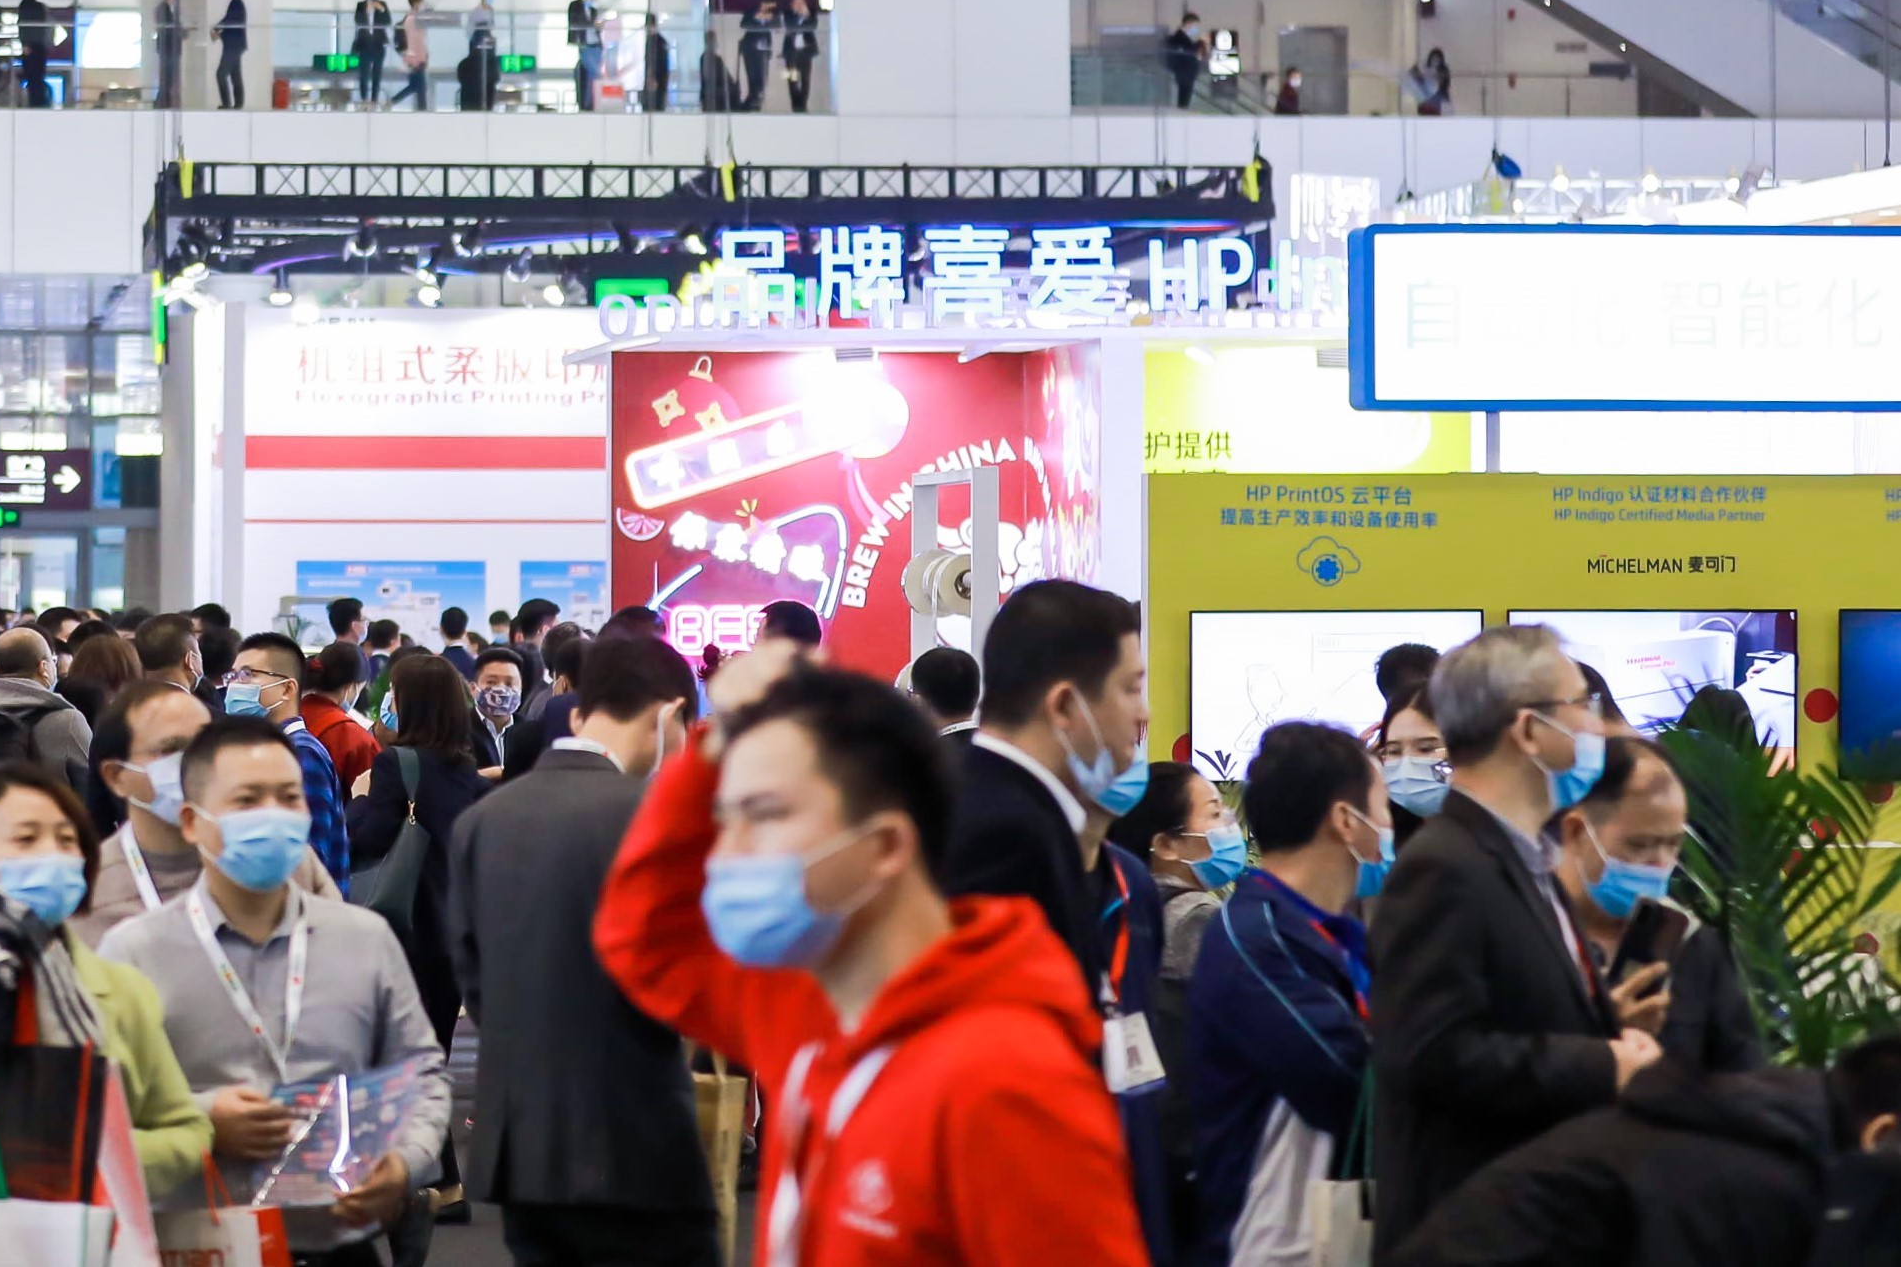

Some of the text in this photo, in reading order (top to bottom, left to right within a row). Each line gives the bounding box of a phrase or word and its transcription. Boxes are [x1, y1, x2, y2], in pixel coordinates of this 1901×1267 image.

[711, 224, 1116, 320] 品牌喜爱
[1149, 237, 1254, 312] HP
[471, 389, 574, 407] Printing
[1246, 485, 1413, 506] HP PrintOS 云平台
[1552, 485, 1767, 504] HP Indigo 认证材料合作伙伴
[1220, 507, 1438, 530] 提高生产效率和设备使用率
[1554, 507, 1766, 523] HP Indigo Certified Media Partner
[841, 515, 890, 608] BREW
[1587, 555, 1736, 574] MICHELMAN 麦可门
